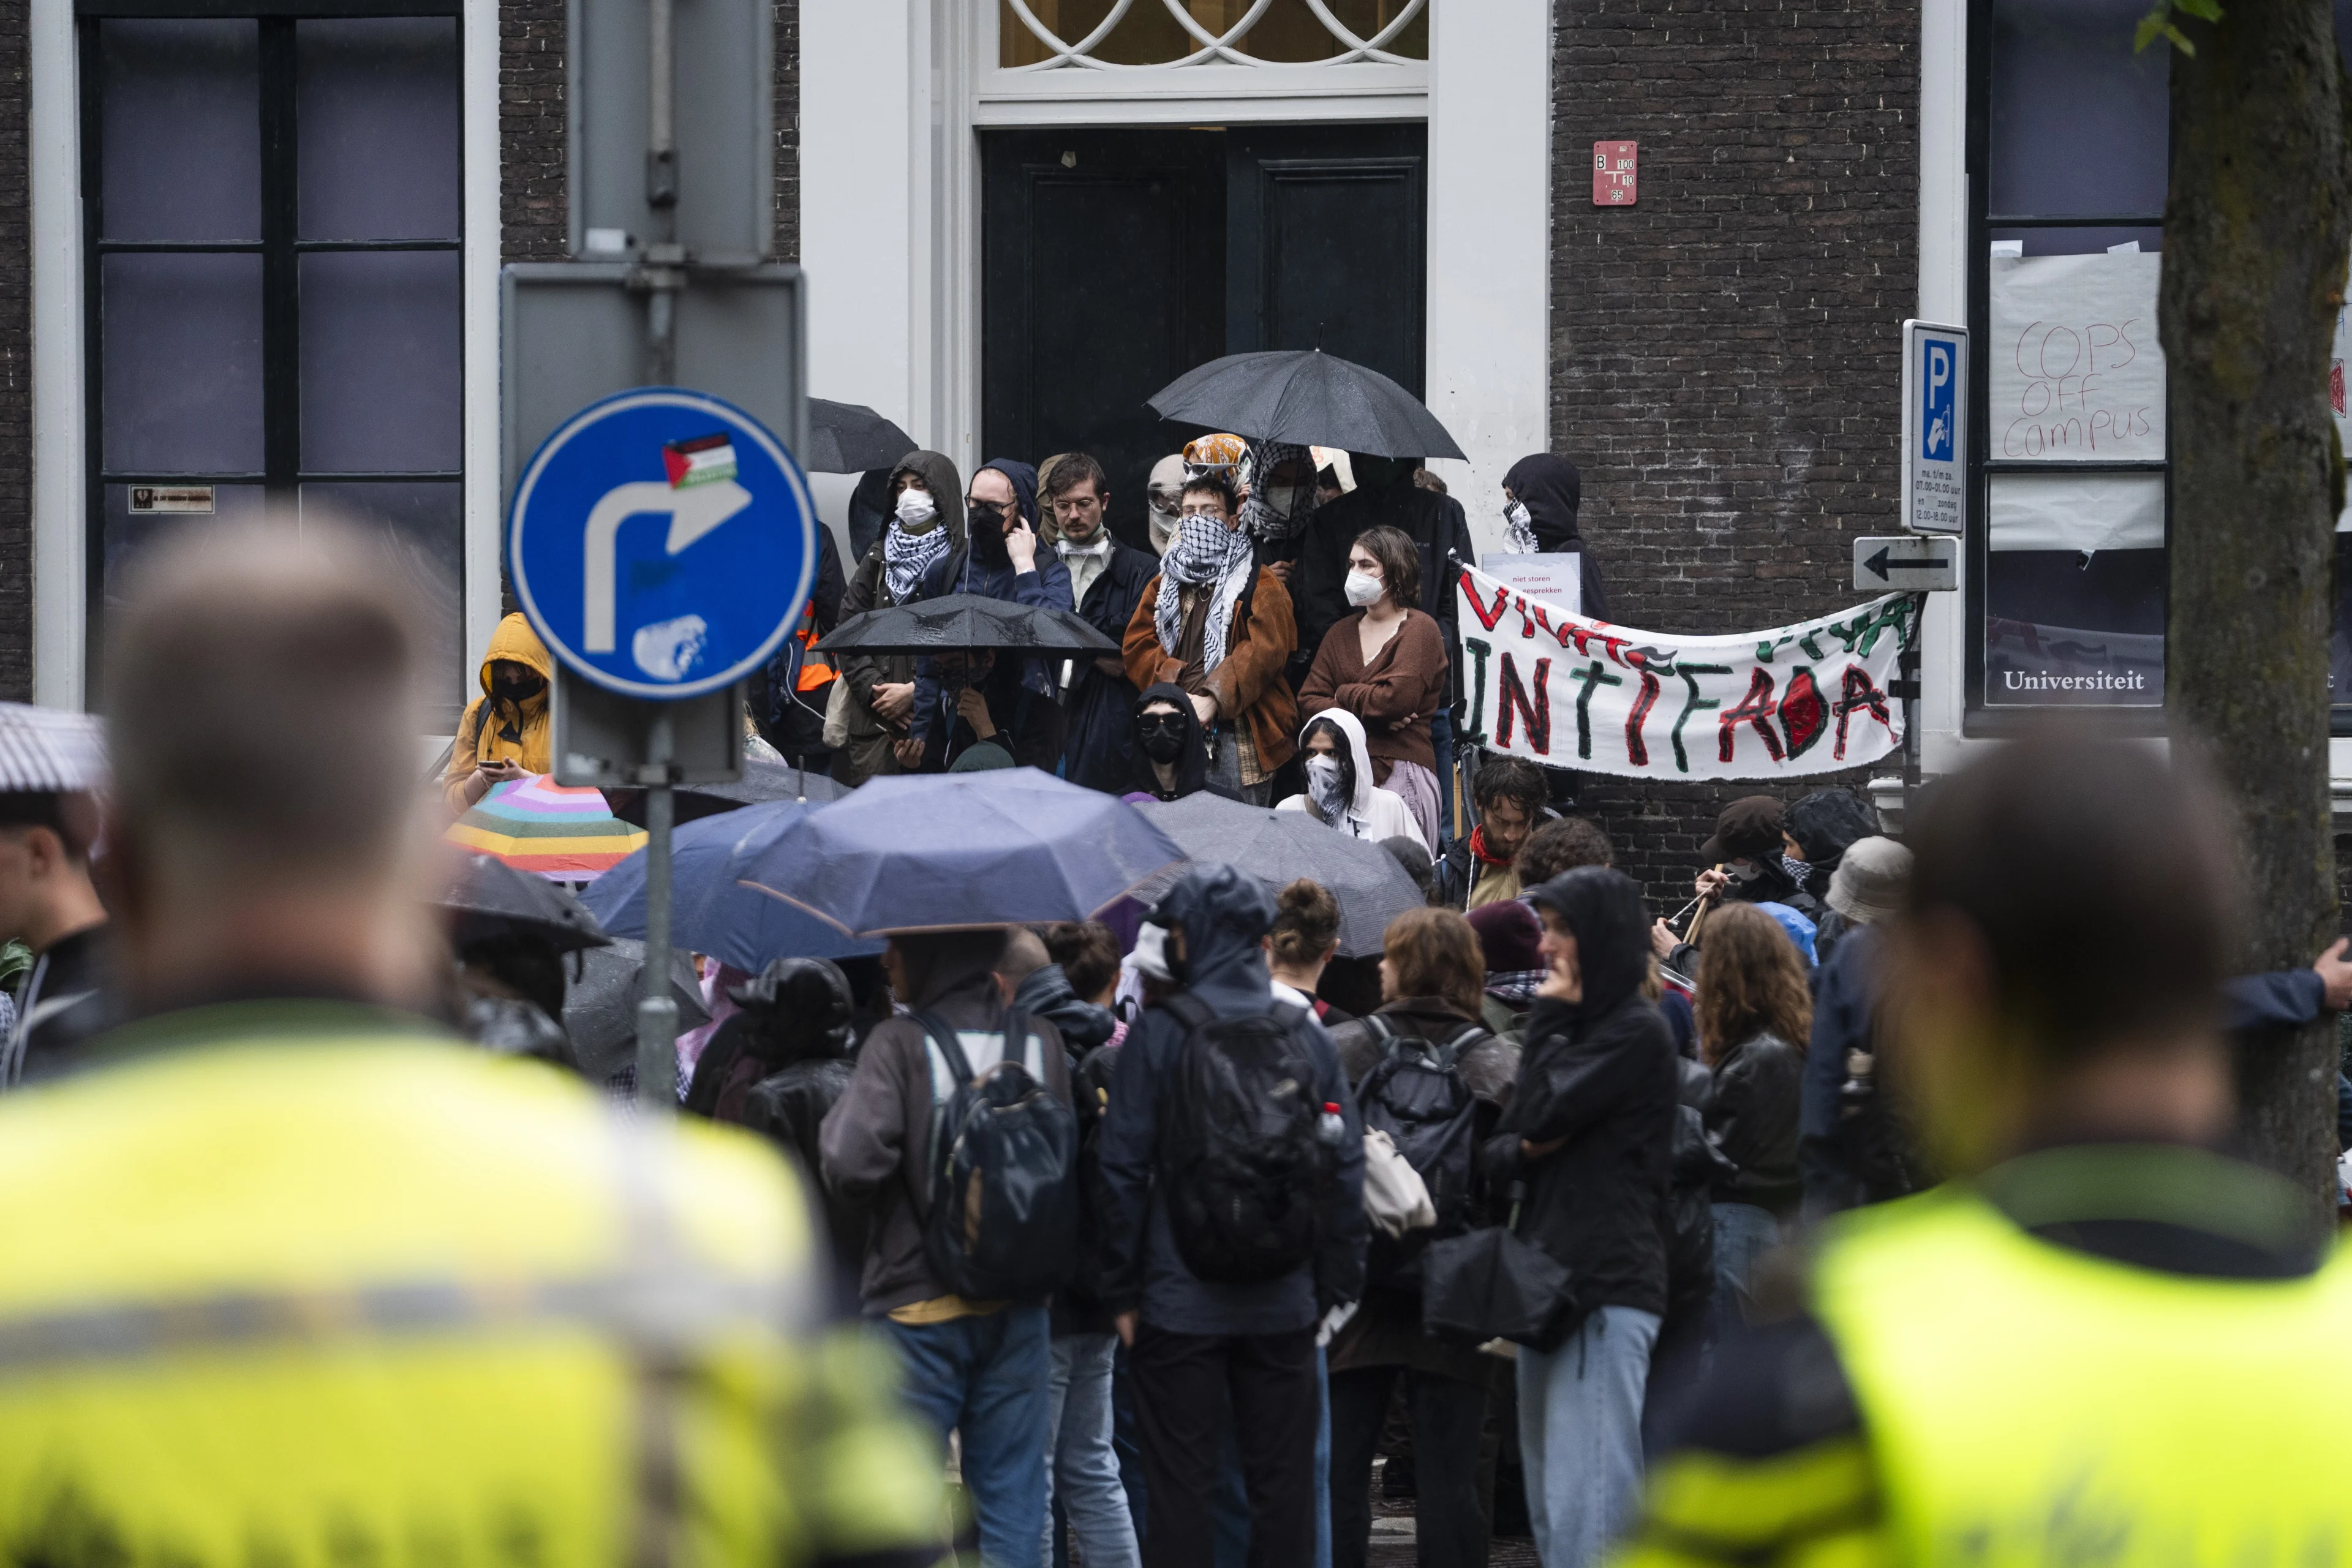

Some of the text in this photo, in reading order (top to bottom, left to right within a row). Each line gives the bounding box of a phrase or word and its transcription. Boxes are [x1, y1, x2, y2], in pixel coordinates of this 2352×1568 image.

[1597, 156, 1634, 169] B 100
[2016, 318, 2140, 379] COPS
[1929, 346, 1949, 409] P
[1933, 469, 1944, 480] t/m
[1916, 480, 1950, 494] 07.00-01.00
[1938, 499, 1957, 511] zondag
[1916, 510, 1948, 522] 12.00-18.00
[2003, 670, 2144, 690] Universiteit
[1464, 637, 1899, 773] INTIFADA
